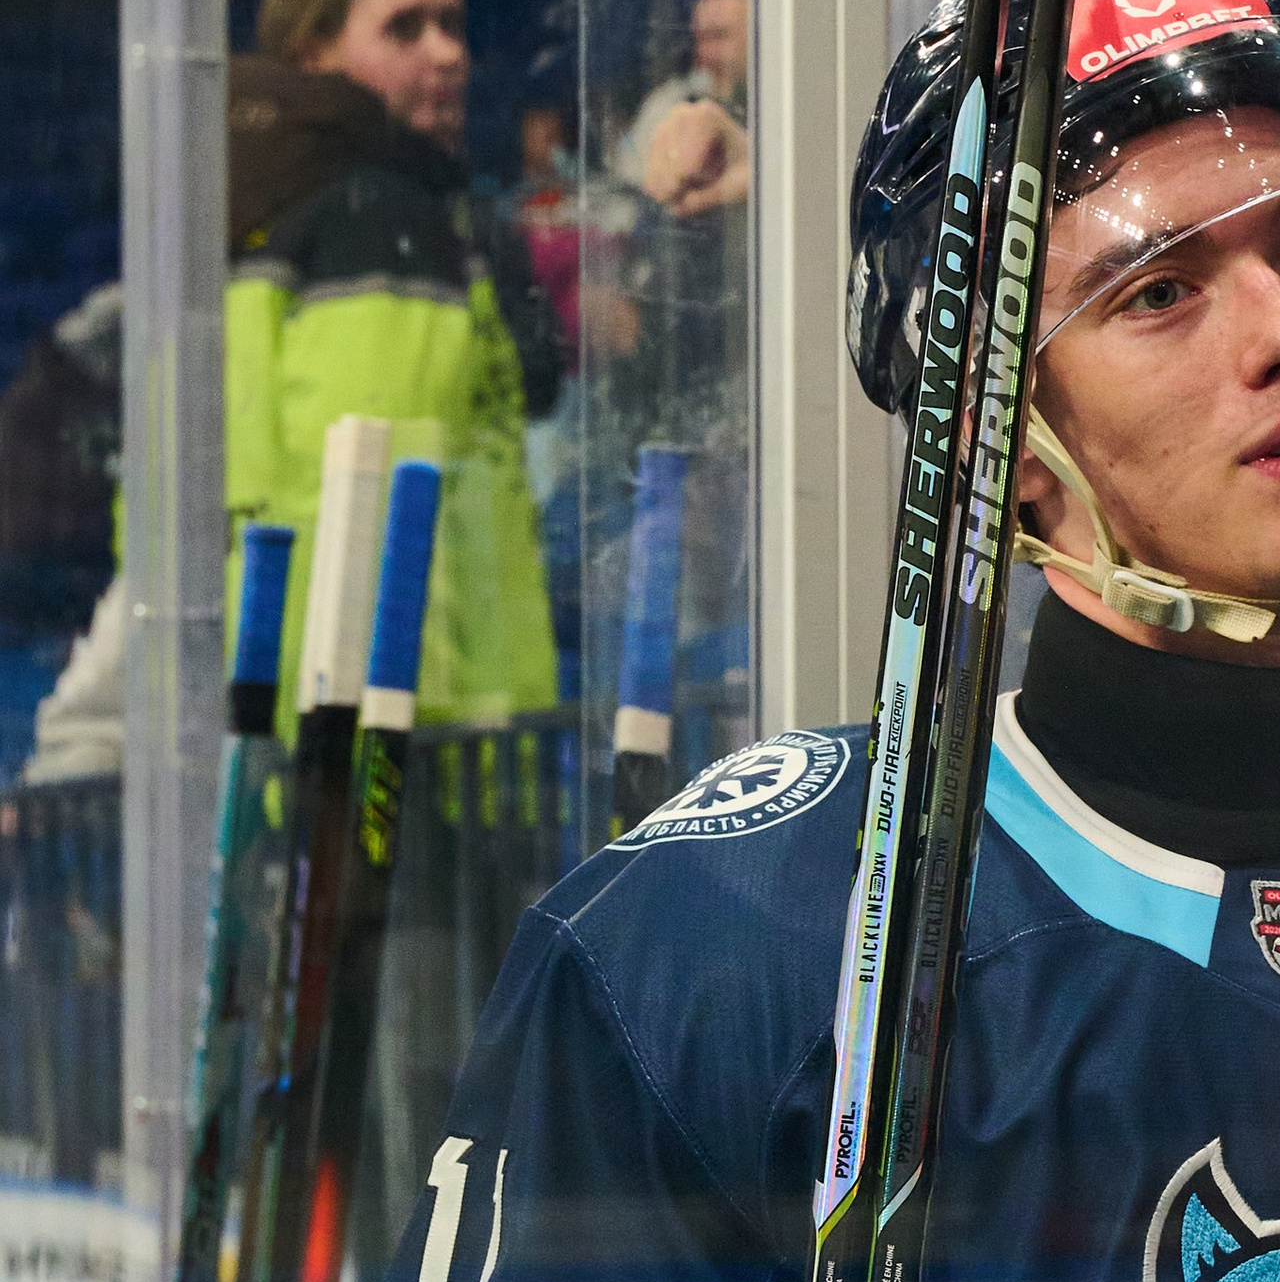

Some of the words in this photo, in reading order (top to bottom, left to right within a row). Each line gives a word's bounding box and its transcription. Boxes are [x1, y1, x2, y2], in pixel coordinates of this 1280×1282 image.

[1081, 6, 1252, 73] OLIMPBET
[894, 172, 979, 628] SHERWOOD
[959, 161, 1042, 612] SHERWOOD
[890, 681, 907, 743] KICKPOINT
[644, 816, 746, 839] ОБЛАСТЬ
[858, 893, 884, 984] BLACKLINE
[885, 1243, 896, 1267] CHINE
